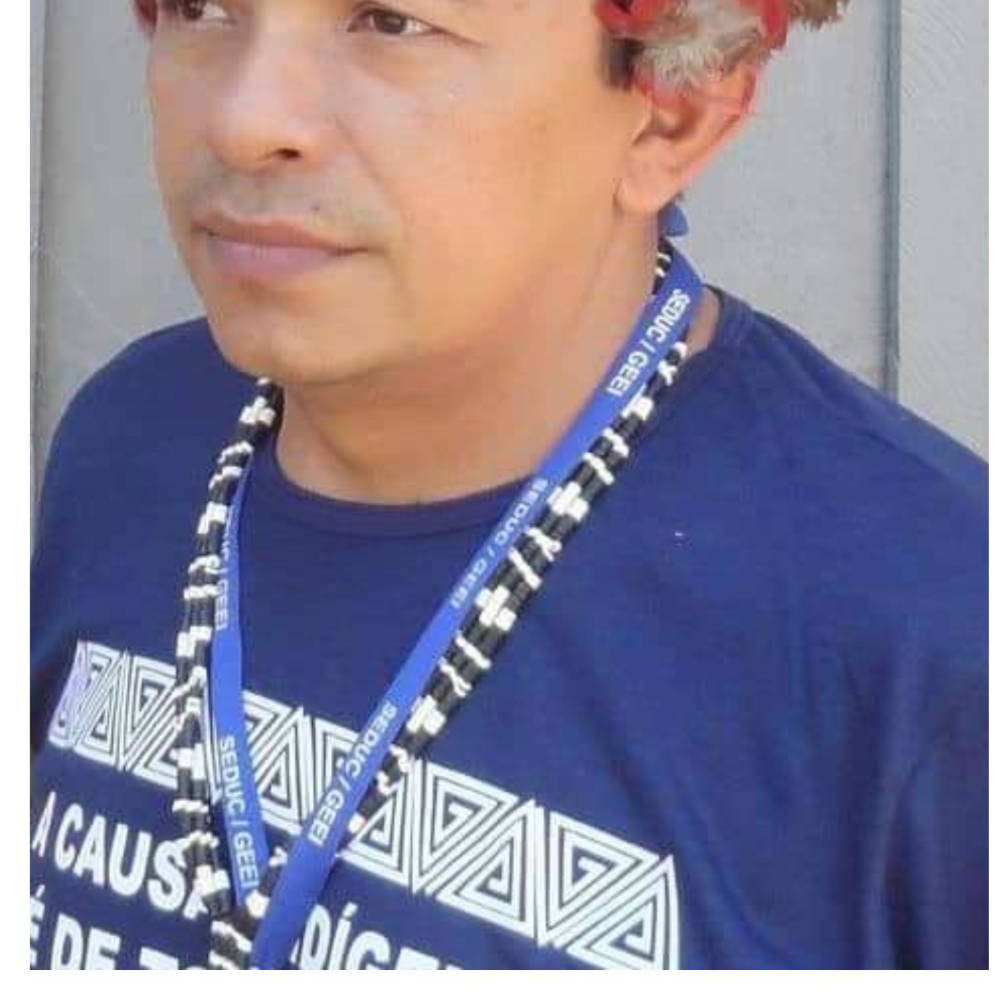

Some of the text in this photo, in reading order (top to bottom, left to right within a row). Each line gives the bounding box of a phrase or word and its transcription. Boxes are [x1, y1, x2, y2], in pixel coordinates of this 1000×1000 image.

[645, 288, 691, 344] SEDUC
[607, 351, 649, 397] GEEI
[344, 700, 398, 777] SEDUC
[31, 791, 57, 858] A
[220, 735, 246, 817] SEDUC
[233, 831, 260, 889] GEEI
[308, 788, 345, 847] GEEI
